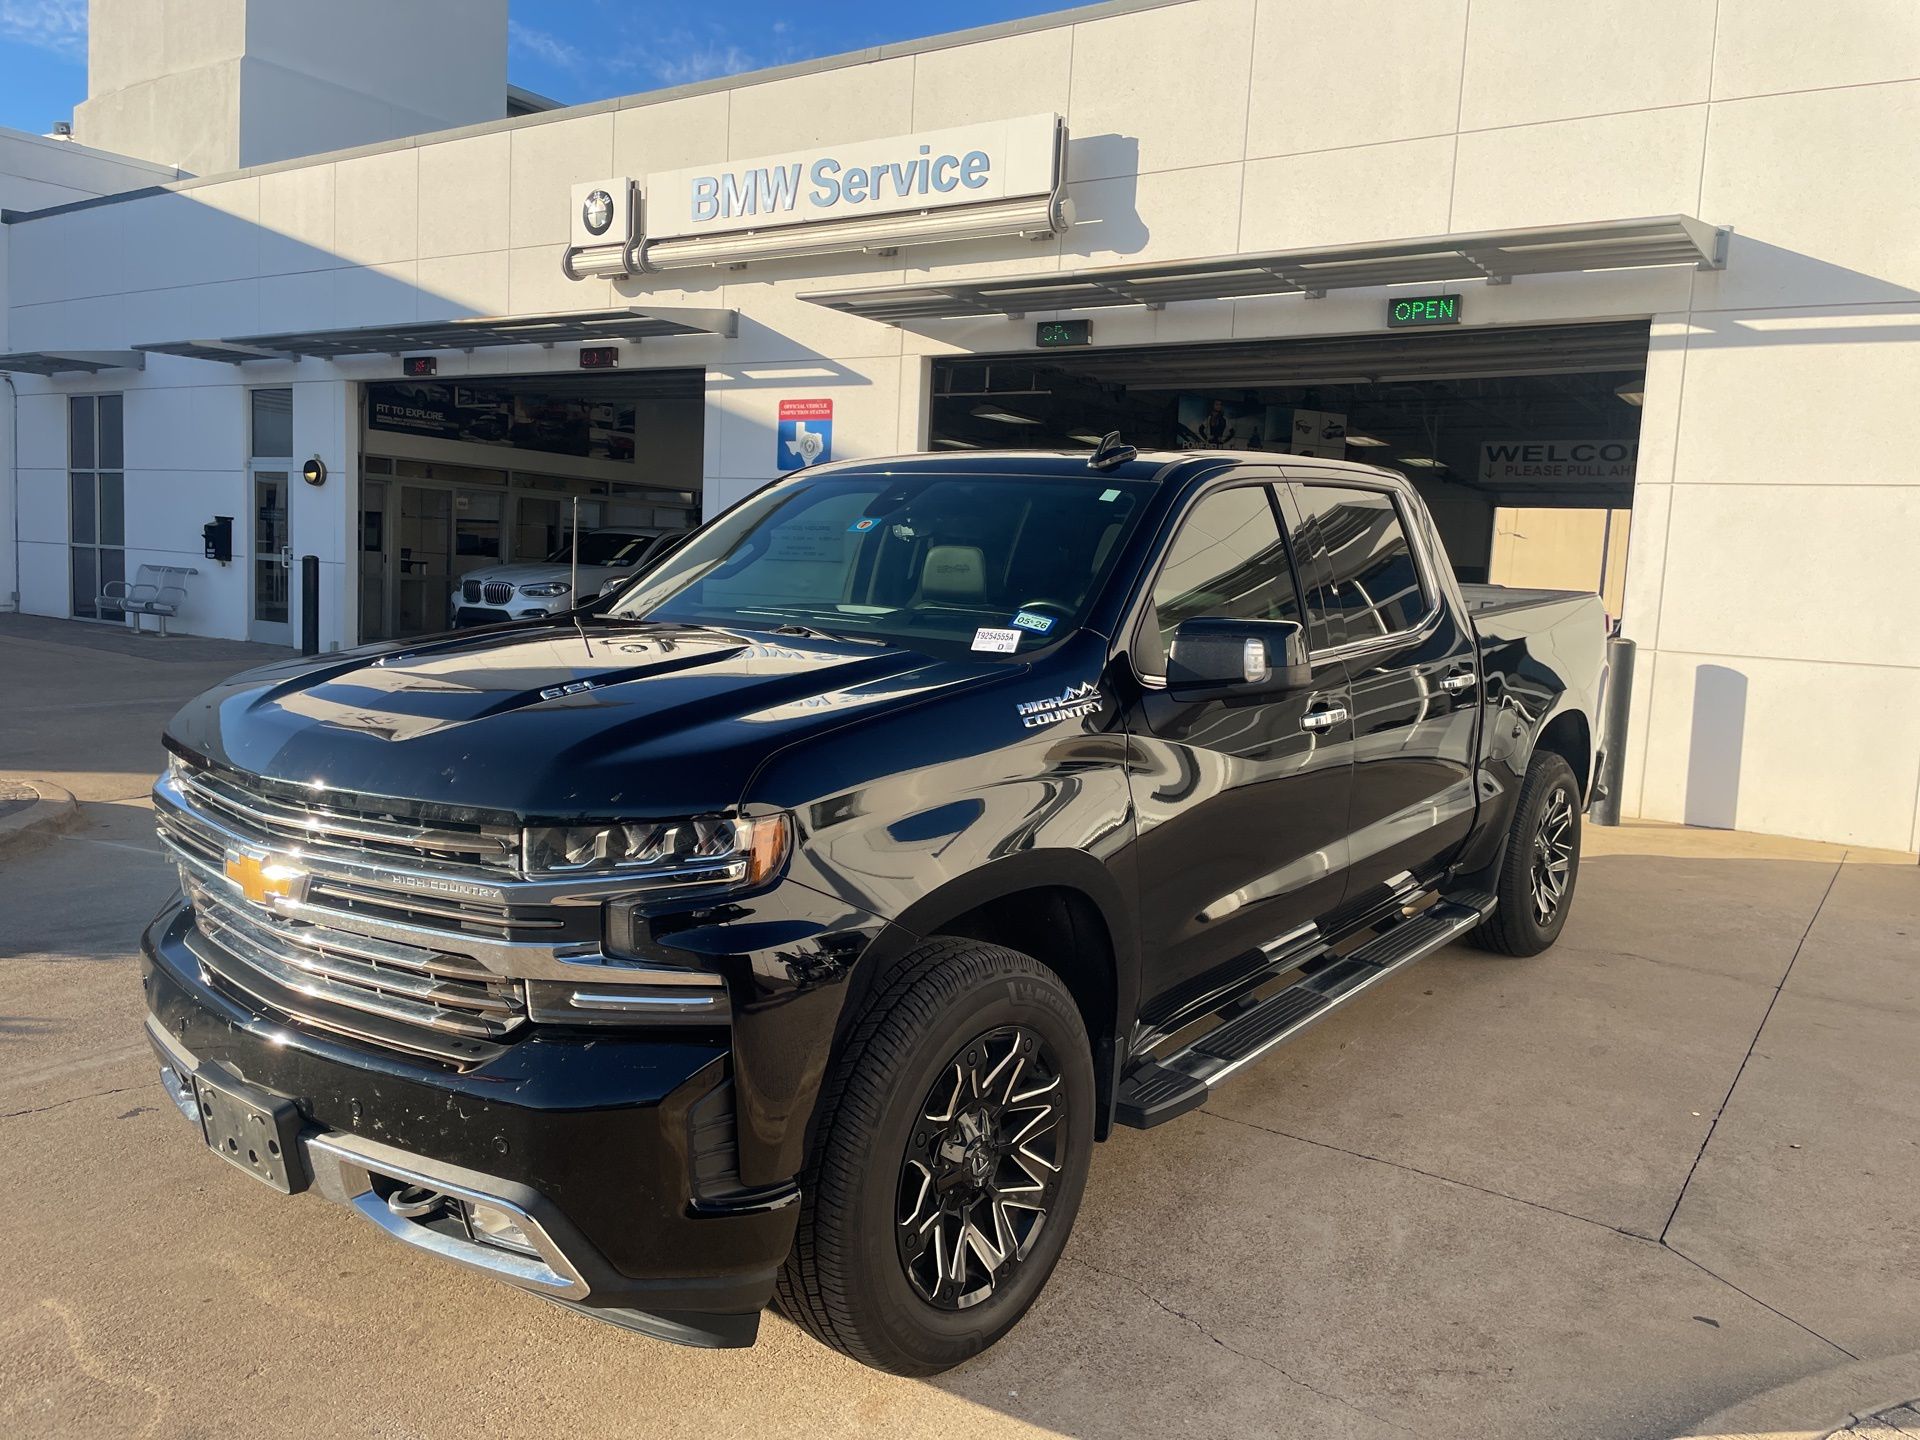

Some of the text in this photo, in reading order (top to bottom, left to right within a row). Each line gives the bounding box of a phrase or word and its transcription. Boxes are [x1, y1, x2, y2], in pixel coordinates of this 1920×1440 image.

[690, 144, 991, 223] BMW Service
[1395, 299, 1454, 321] OPEN
[376, 403, 389, 414] FIT
[391, 405, 404, 415] TO
[1486, 443, 1637, 463] WELCO
[1504, 464, 1634, 477] PLEASE PULL AH
[1017, 696, 1062, 715] HIGH
[1023, 701, 1102, 728] COUNTRY
[392, 874, 501, 898] HIGH COUNTRY
